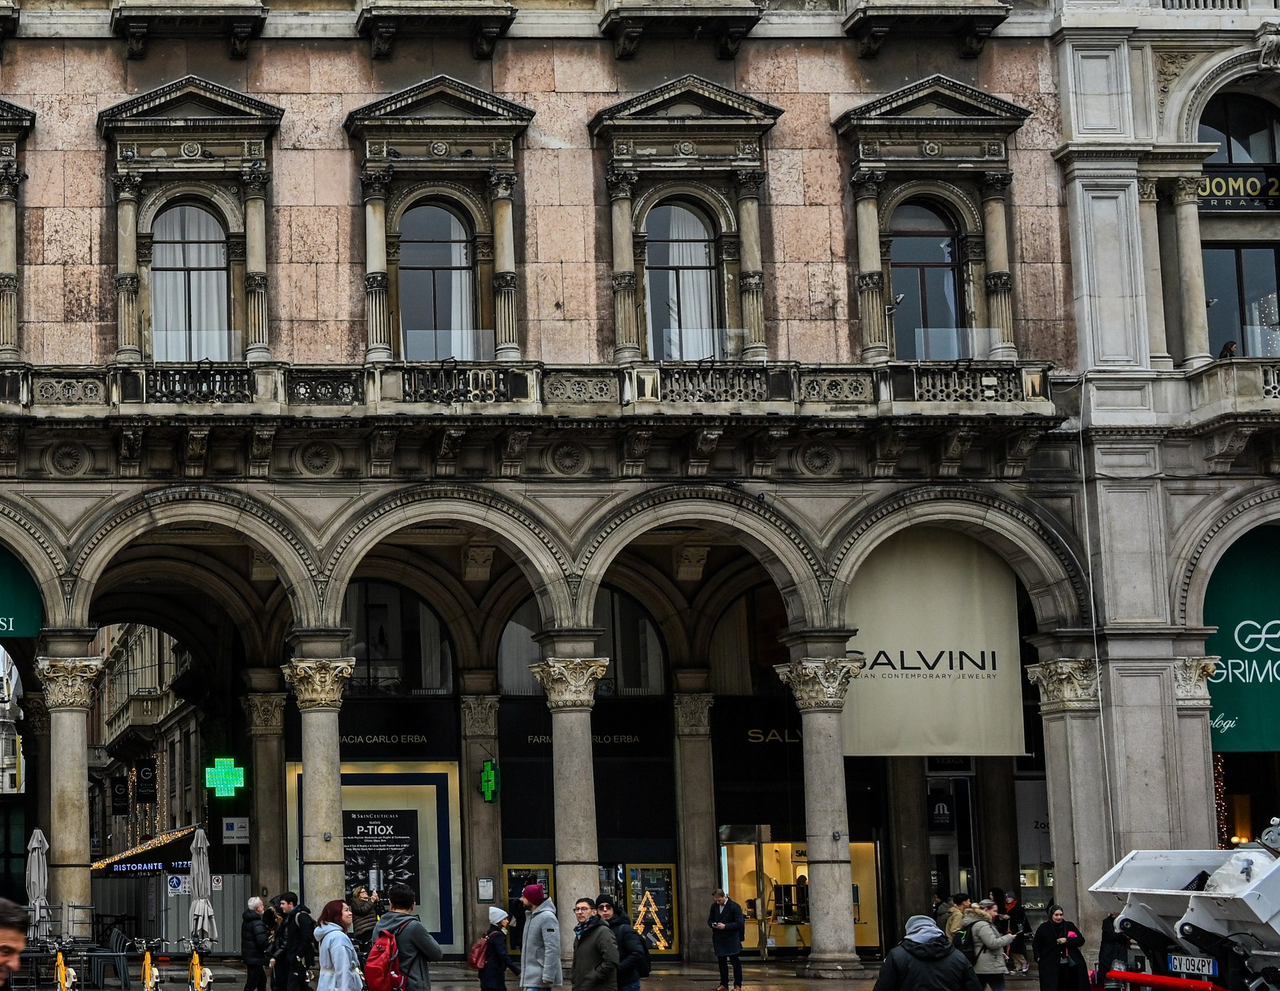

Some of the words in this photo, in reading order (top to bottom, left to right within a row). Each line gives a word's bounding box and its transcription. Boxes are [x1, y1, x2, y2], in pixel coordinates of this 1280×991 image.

[1198, 177, 1261, 196] UOMO
[1207, 659, 1280, 683] GRIM
[339, 735, 364, 743] ACIA
[365, 735, 399, 743] CARLO
[400, 735, 427, 743] ERBA
[591, 735, 611, 743] RLO
[613, 735, 640, 743] ERBA
[356, 825, 394, 835] P-TIOX
[113, 863, 163, 872] RISTORANTE
[172, 861, 192, 869] IZZE
